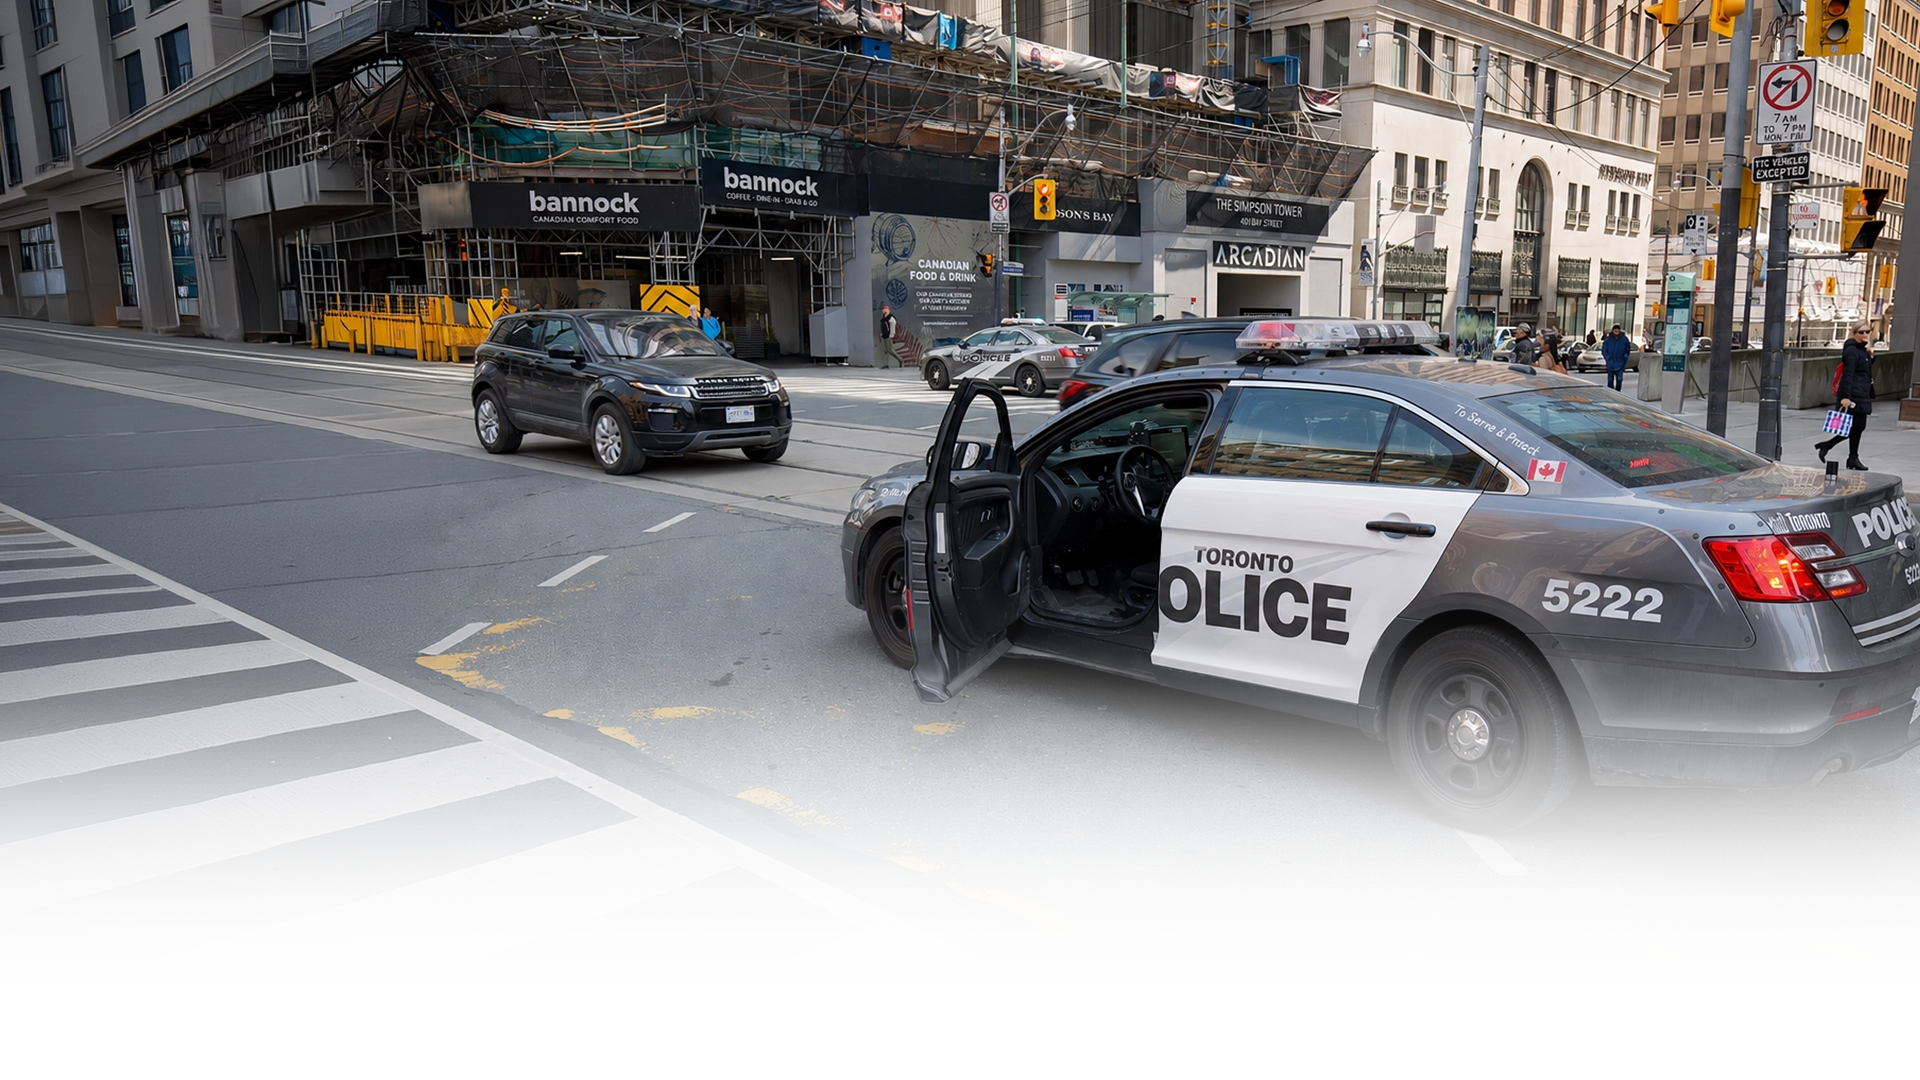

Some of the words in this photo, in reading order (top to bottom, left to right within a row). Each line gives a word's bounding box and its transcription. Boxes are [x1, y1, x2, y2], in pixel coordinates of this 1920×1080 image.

[1763, 125, 1775, 133] TO
[1783, 123, 1790, 133] 7
[1792, 124, 1806, 132] PM
[1764, 133, 1782, 141] MON
[1772, 155, 1808, 167] VEHICLES
[1756, 166, 1805, 179] EXCEPTED
[723, 166, 819, 197] bannock
[529, 190, 640, 213] bannock
[726, 192, 751, 201] COFFEE
[1216, 197, 1233, 212] THE
[1234, 199, 1272, 215] SIMPSON
[1273, 203, 1303, 218] TOWER
[532, 215, 575, 223] CANADIAN
[575, 216, 615, 224] COMFORT
[616, 216, 639, 225] FOOD
[1093, 211, 1114, 222] BAY
[1263, 218, 1283, 228] STREET
[1215, 243, 1304, 269] ARCADIAN
[918, 259, 970, 271] CANADIAN
[909, 270, 938, 280] FOOD
[939, 272, 946, 281] &
[948, 272, 977, 283] DRINK
[1454, 403, 1466, 418] To
[1496, 427, 1507, 438] &
[1194, 545, 1294, 574] TORONTO
[1159, 564, 1352, 646] OLICE
[1541, 578, 1664, 623] 5222
